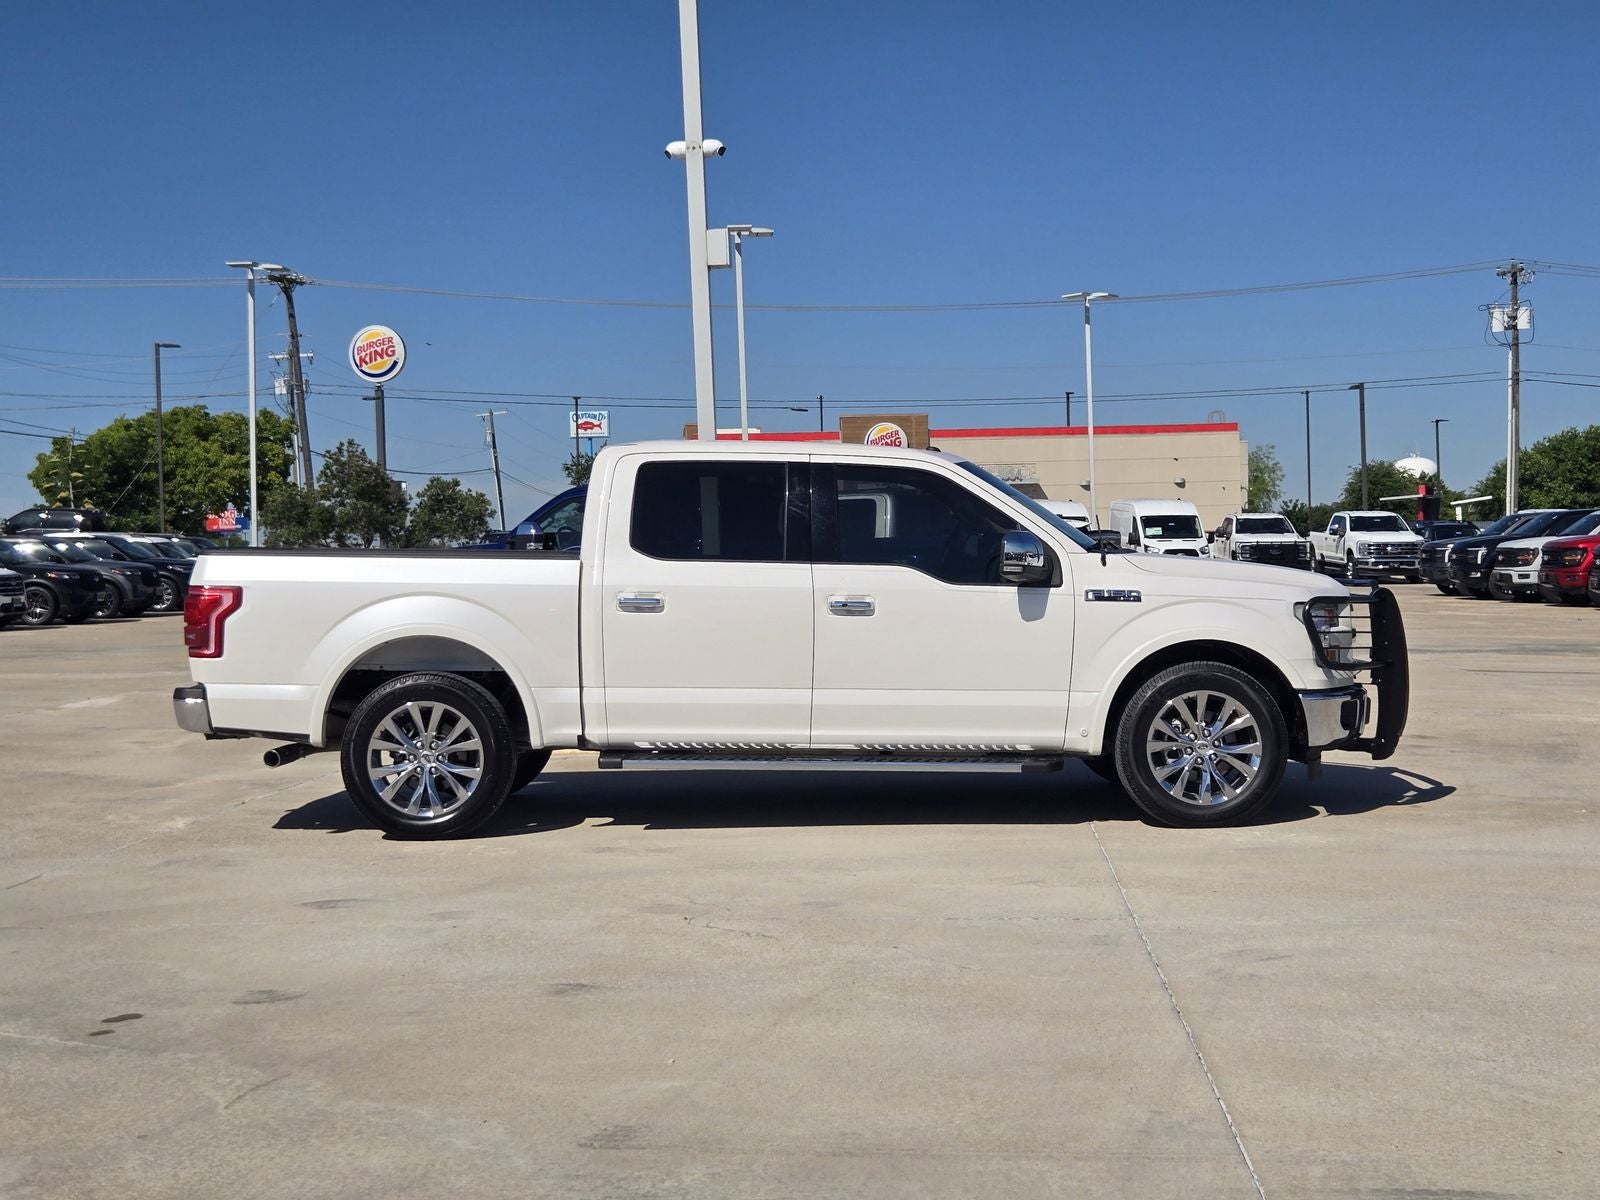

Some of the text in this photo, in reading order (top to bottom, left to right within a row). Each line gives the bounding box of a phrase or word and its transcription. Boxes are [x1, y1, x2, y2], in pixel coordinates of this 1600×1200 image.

[357, 336, 394, 355] BURGER
[358, 345, 396, 368] KING
[870, 430, 899, 446] BURGER
[881, 436, 902, 447] NG
[219, 517, 235, 525] INN
